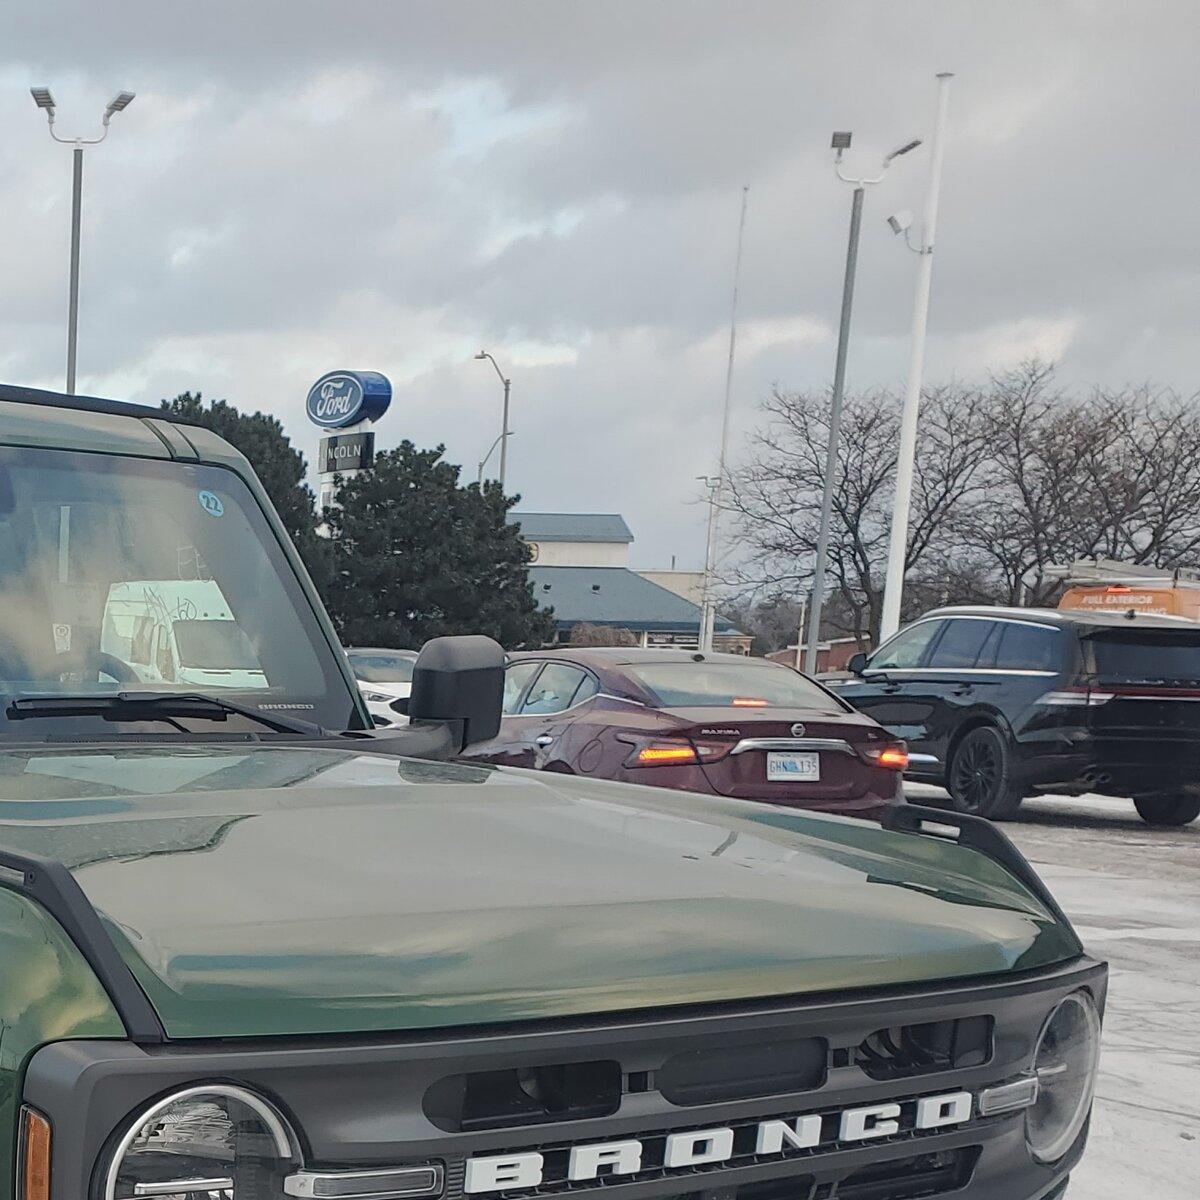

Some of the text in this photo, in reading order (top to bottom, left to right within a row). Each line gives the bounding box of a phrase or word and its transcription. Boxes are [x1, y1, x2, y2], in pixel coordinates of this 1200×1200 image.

[317, 381, 353, 416] Ford
[325, 444, 362, 460] NCOLN
[202, 494, 223, 513] 22
[1081, 595, 1154, 604] FULL EXTERIOR
[464, 1091, 972, 1194] BRONCO
